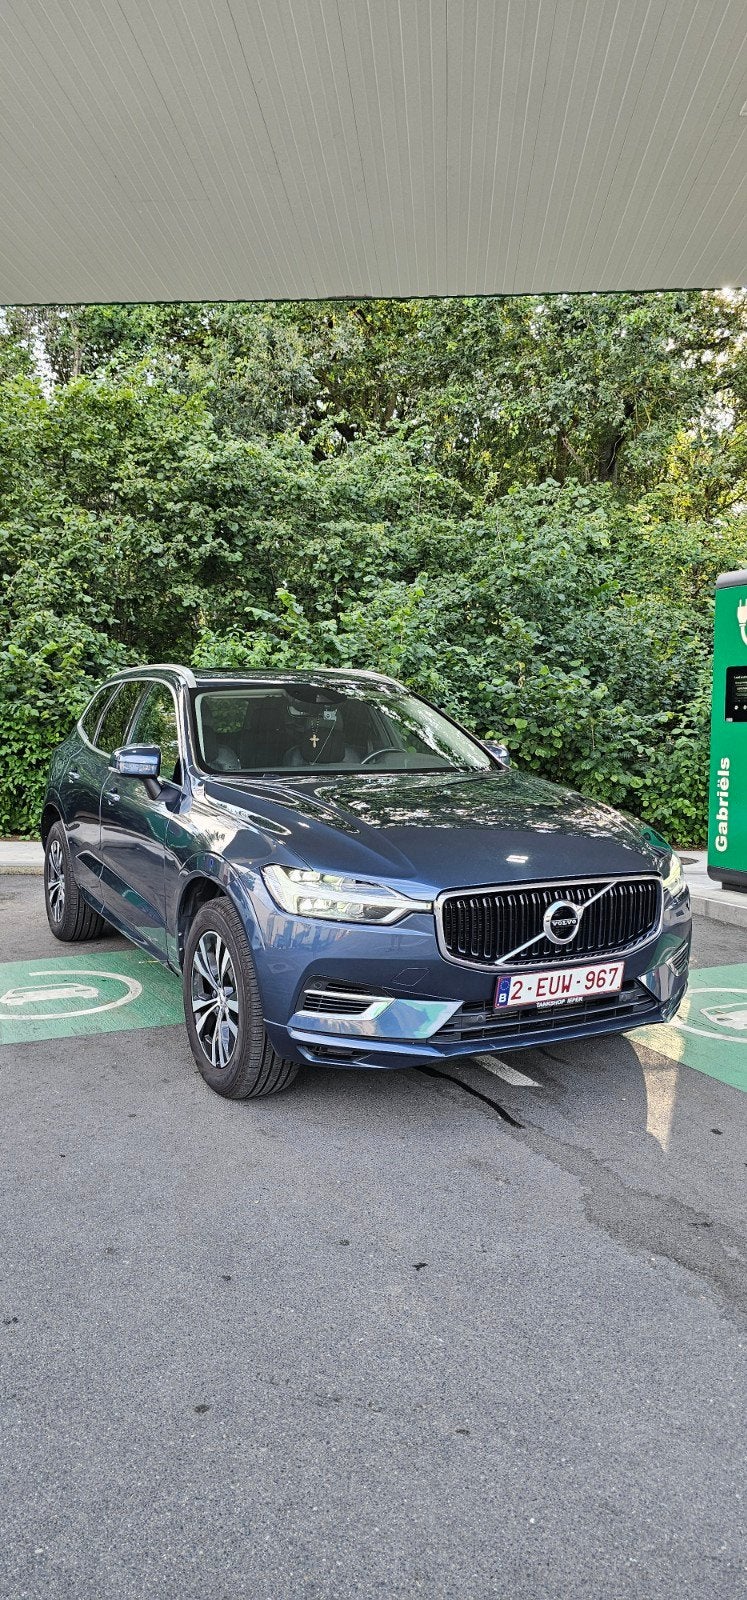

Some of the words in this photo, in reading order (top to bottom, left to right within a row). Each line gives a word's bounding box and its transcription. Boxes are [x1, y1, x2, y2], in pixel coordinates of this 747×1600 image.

[714, 757, 730, 852] Gabriëls
[551, 919, 577, 927] VOLVO
[498, 993, 507, 1003] B
